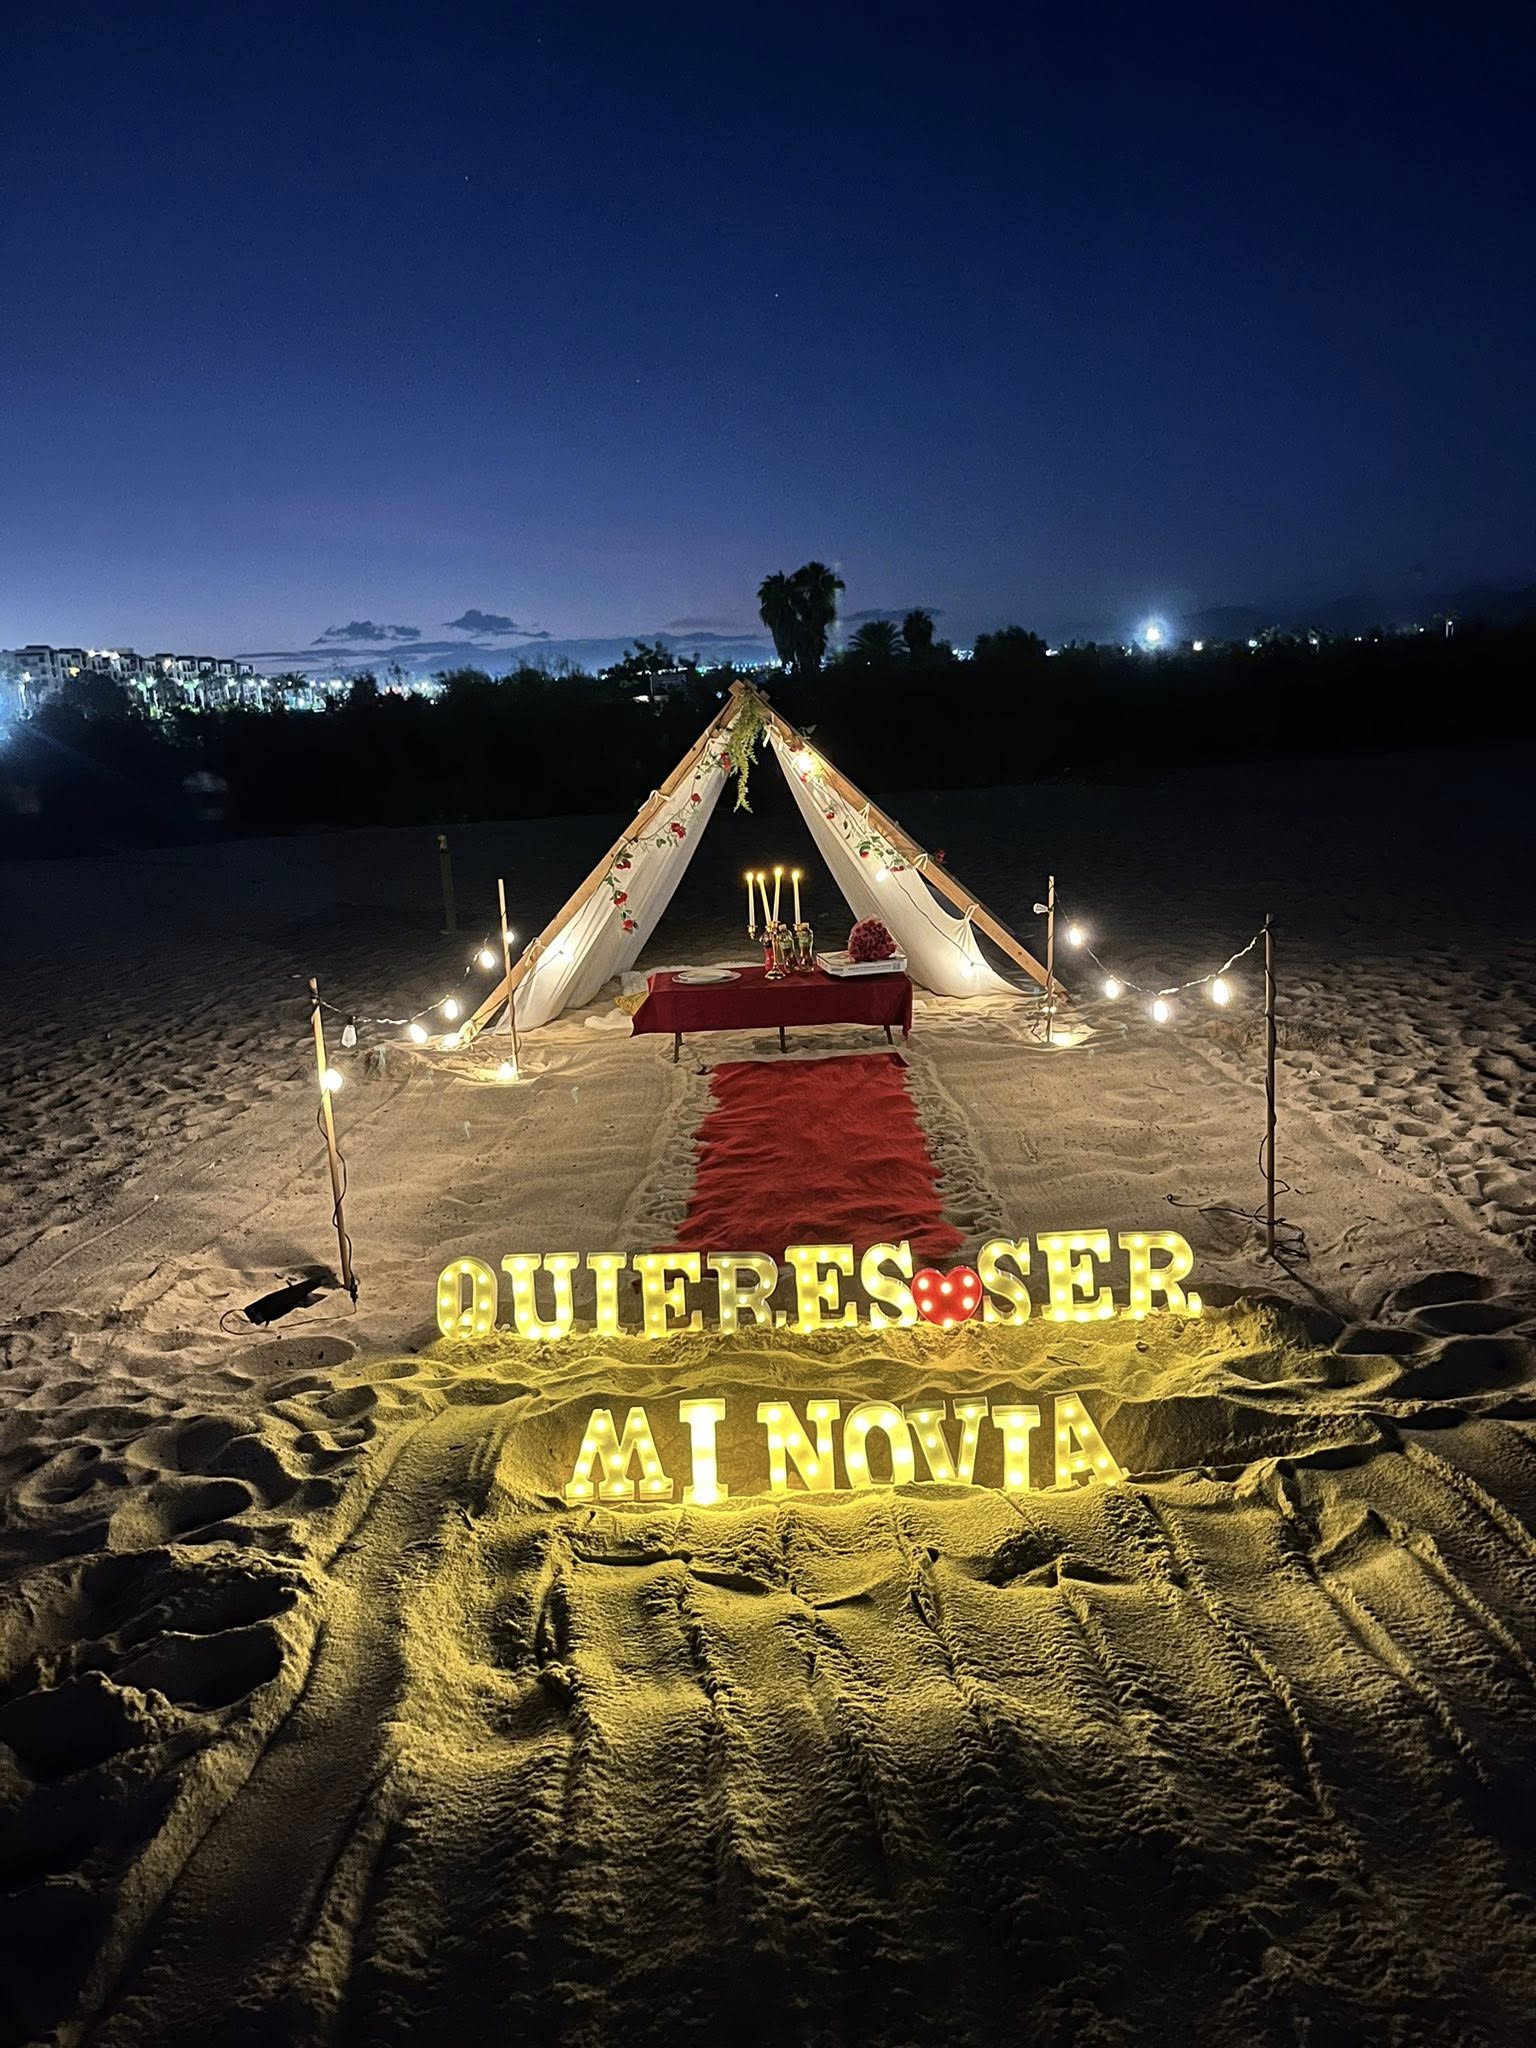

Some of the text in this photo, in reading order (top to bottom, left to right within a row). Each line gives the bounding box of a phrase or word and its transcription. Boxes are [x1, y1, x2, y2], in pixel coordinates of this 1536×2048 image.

[437, 1229, 1203, 1341] QUIERES SER
[565, 1392, 1128, 1505] MI NOVIA
